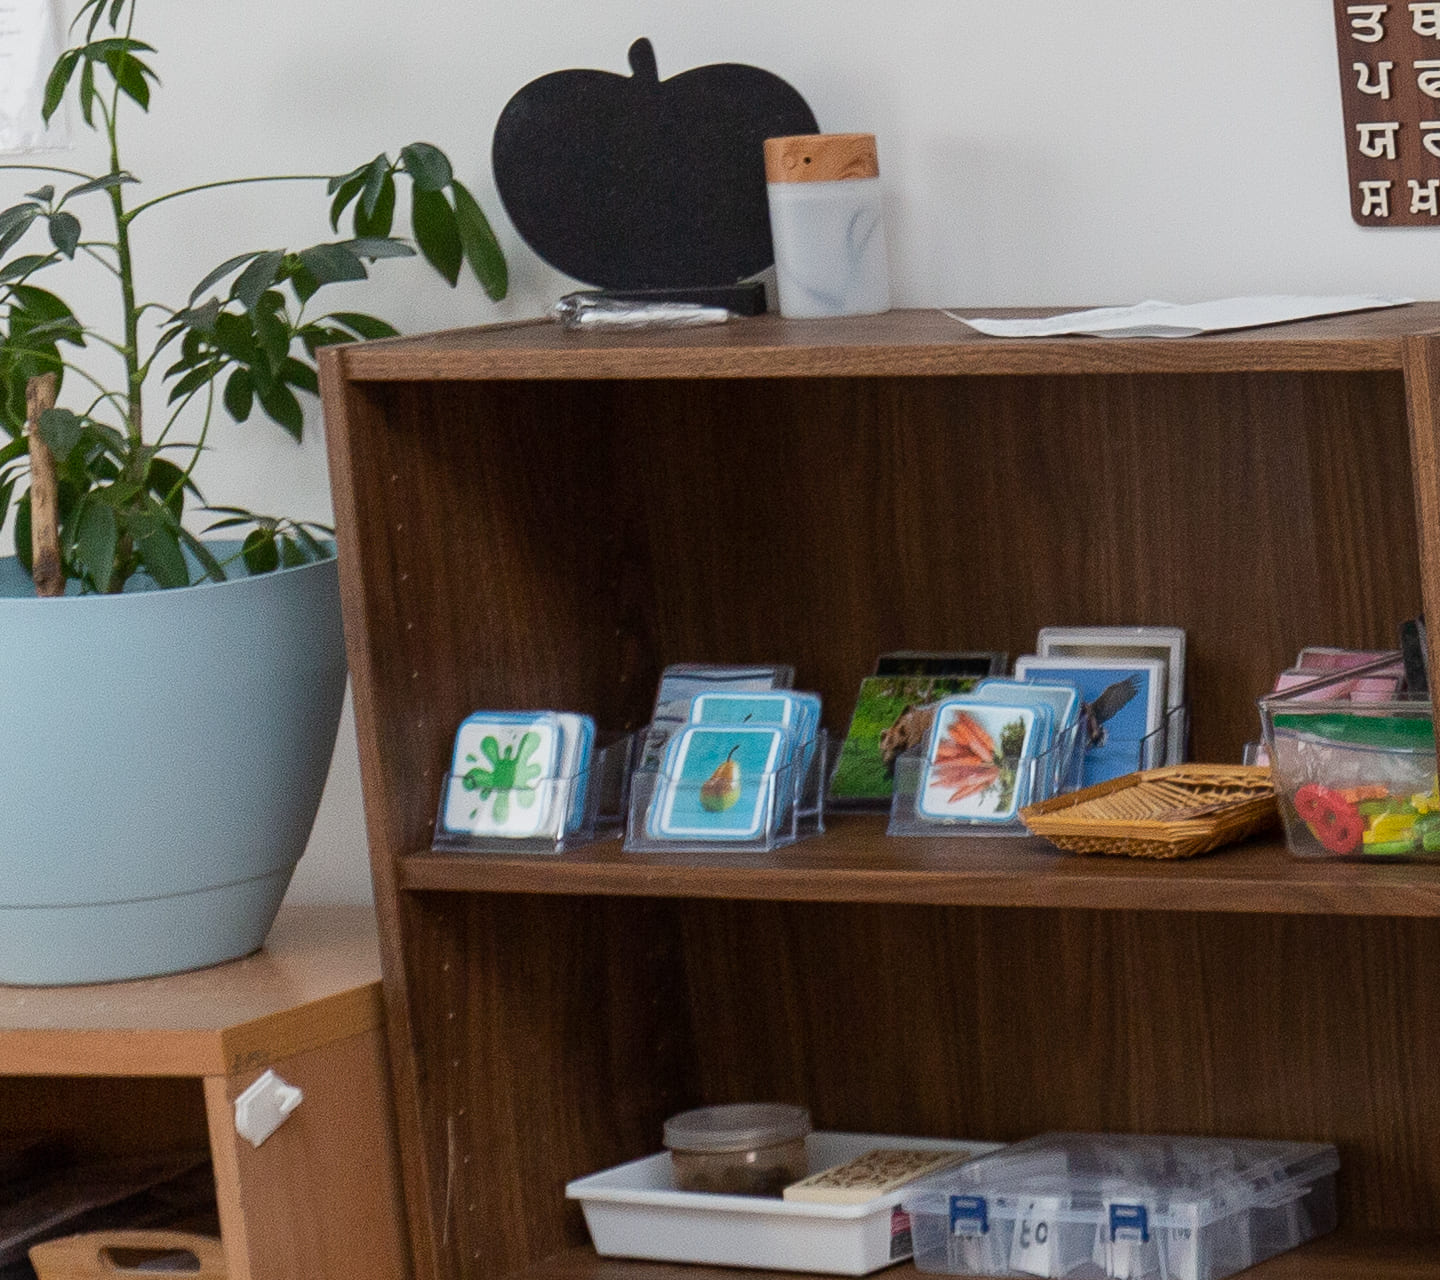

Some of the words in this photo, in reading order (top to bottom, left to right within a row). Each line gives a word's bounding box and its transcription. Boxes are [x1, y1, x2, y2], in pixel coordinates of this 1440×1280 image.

[1346, 4, 1387, 43] ਤ
[1353, 61, 1393, 100] ਪ
[1355, 121, 1399, 160] ਯ
